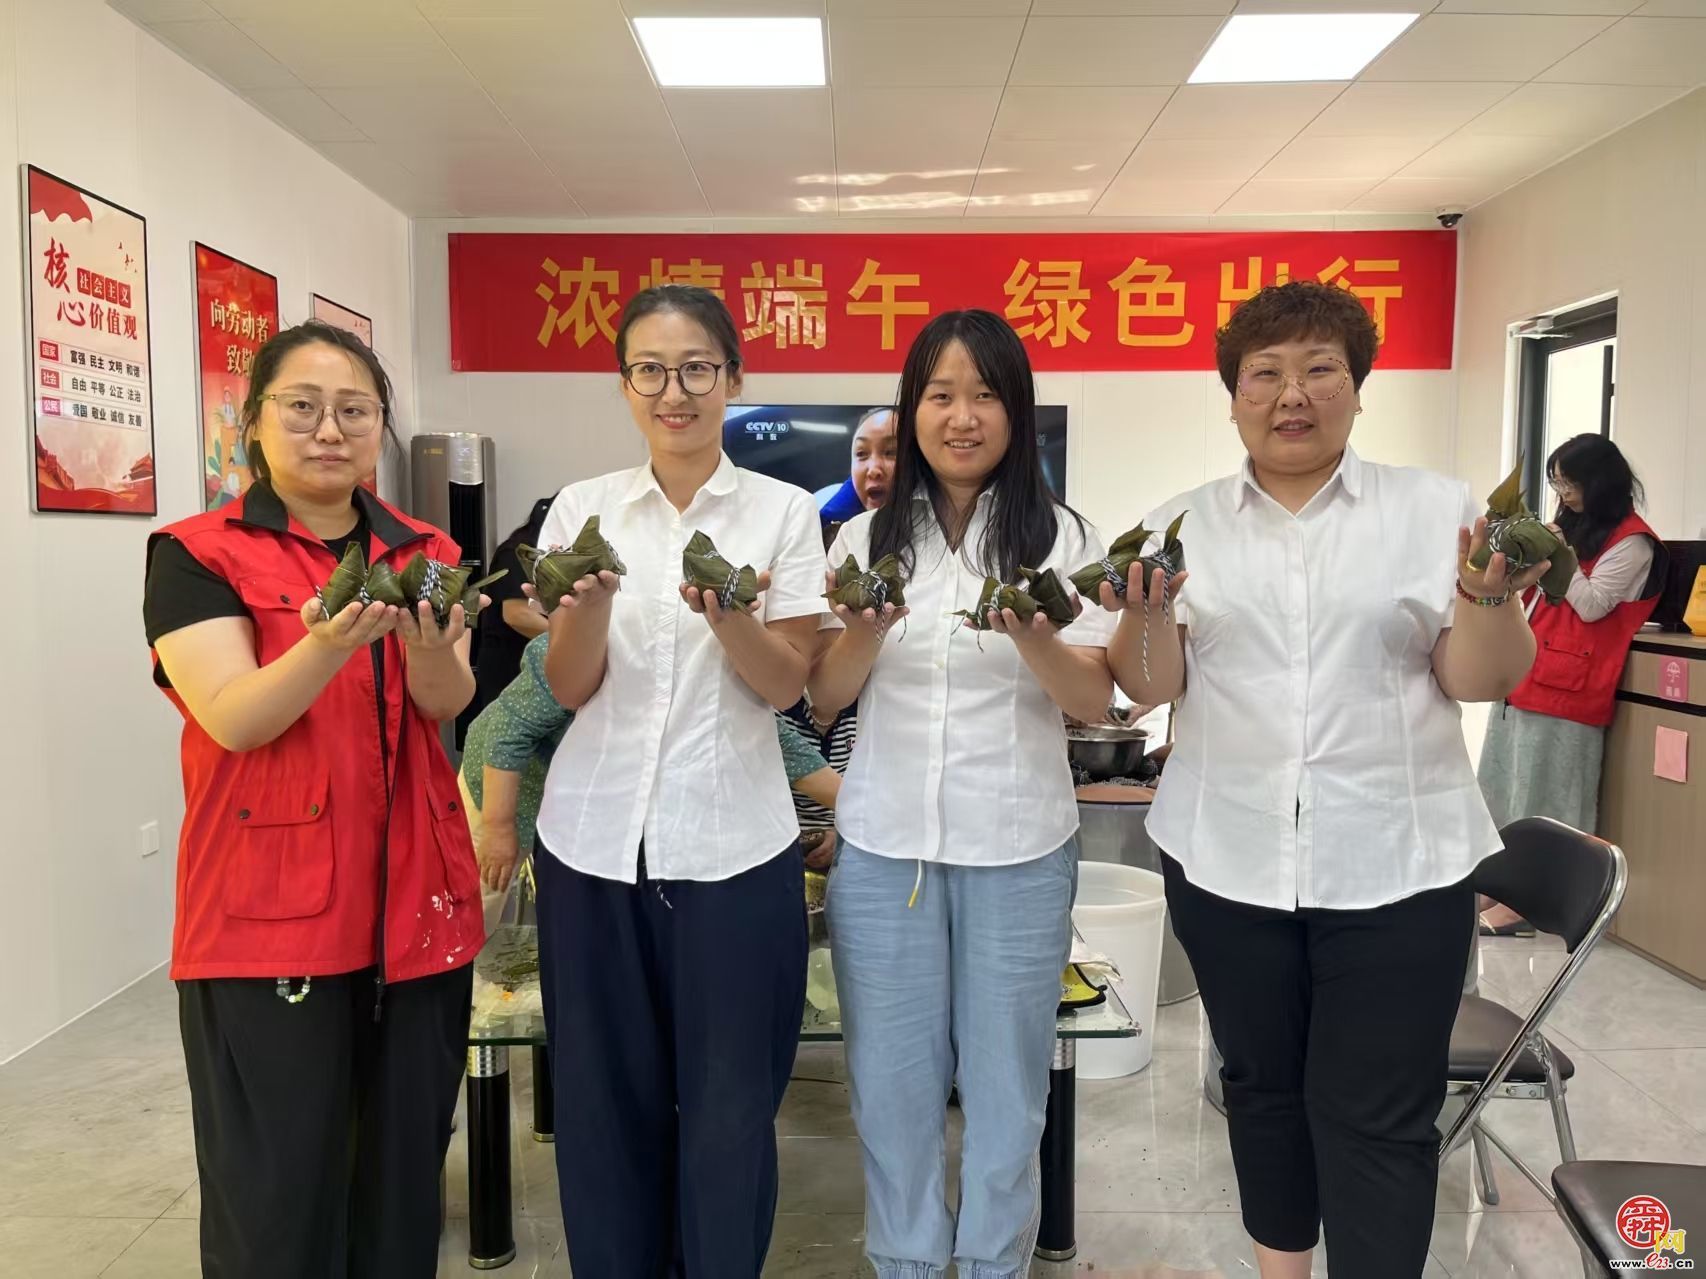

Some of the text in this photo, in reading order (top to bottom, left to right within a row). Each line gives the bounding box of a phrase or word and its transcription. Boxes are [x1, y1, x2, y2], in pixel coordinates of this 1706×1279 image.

[44, 236, 70, 293] 核
[79, 271, 129, 303] 社会主义
[57, 300, 137, 340] 心价值观
[210, 298, 268, 343] 向劳动者
[70, 350, 86, 365] 富强
[90, 355, 105, 370] 民主
[108, 360, 123, 374] 文明
[43, 372, 57, 386] 社会
[72, 377, 141, 402] 自由 平等 公正 法治
[43, 399, 58, 413] 公民
